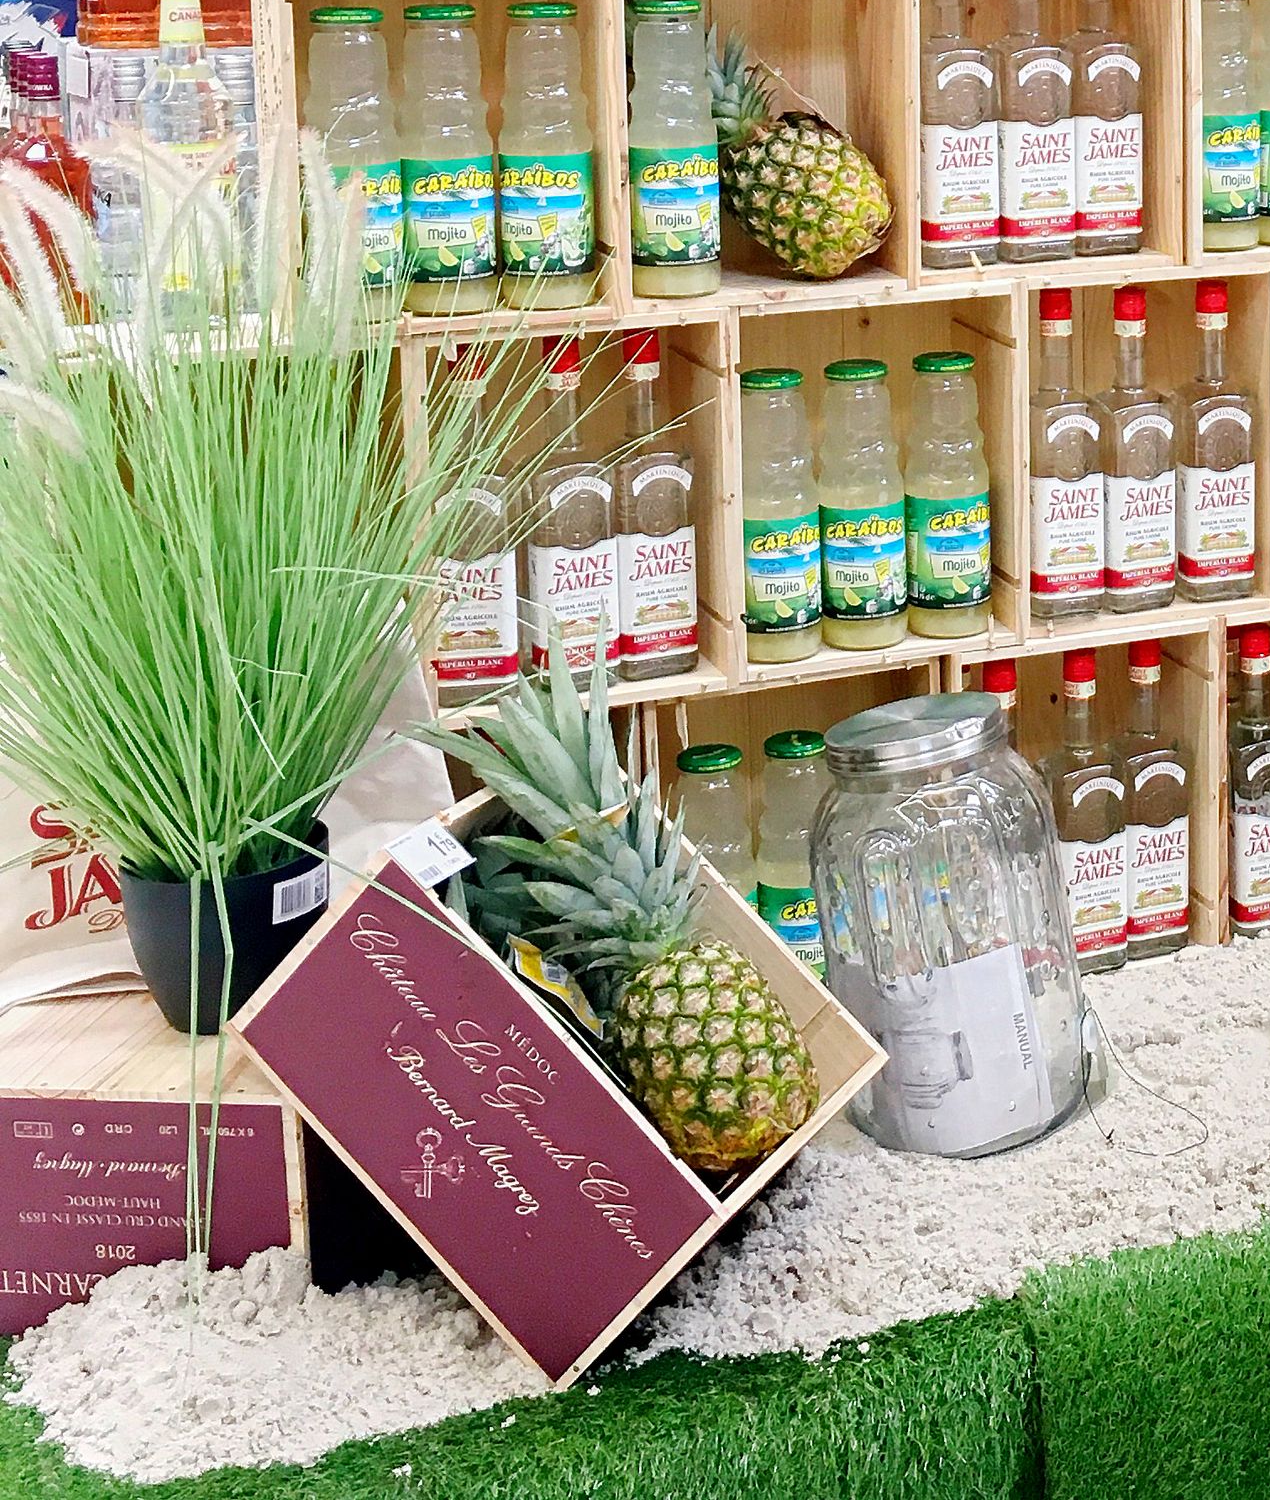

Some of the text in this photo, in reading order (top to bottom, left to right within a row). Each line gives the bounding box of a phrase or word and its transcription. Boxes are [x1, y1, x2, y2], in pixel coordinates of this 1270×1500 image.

[941, 136, 993, 153] SAINT
[1019, 134, 1071, 150] SAINT
[1089, 128, 1139, 145] SAINT
[936, 151, 994, 171] JAMES
[1015, 148, 1071, 168] JAMES
[1084, 143, 1139, 162] JAMES
[1221, 174, 1251, 188] Mojito
[655, 213, 692, 228] Mojito
[428, 226, 467, 241] Mojito
[1125, 485, 1173, 503] SAINT
[1200, 476, 1250, 494] SAINT
[1049, 487, 1099, 505] SAINT
[1195, 491, 1251, 512] JAMES
[1044, 503, 1100, 524] JAMES
[1120, 500, 1173, 521] JAMES
[634, 541, 691, 563] SAINT
[629, 556, 692, 582] JAMES
[942, 558, 976, 573] Mojito
[835, 570, 869, 585] Mojito
[765, 580, 800, 595] Mojito
[1137, 831, 1186, 850] SAINT
[1074, 846, 1124, 867] SAINT
[1131, 845, 1187, 868] JAMES
[1069, 861, 1124, 886] JAMES
[1012, 1011, 1034, 1071] MANUAL
[503, 1021, 562, 1086] MÉDOC
[348, 911, 655, 1261] Château Les Grands Chênes
[105, 1124, 132, 1135] CRD
[159, 1125, 178, 1136] L20
[385, 1042, 541, 1218] Bernard Magrez
[32, 1151, 187, 1181] Bernard Magrez
[63, 1194, 161, 1210] HAUT-MÉDOC
[19, 1209, 47, 1225] 1855
[124, 1212, 154, 1227] CRU
[95, 1243, 135, 1259] 2018
